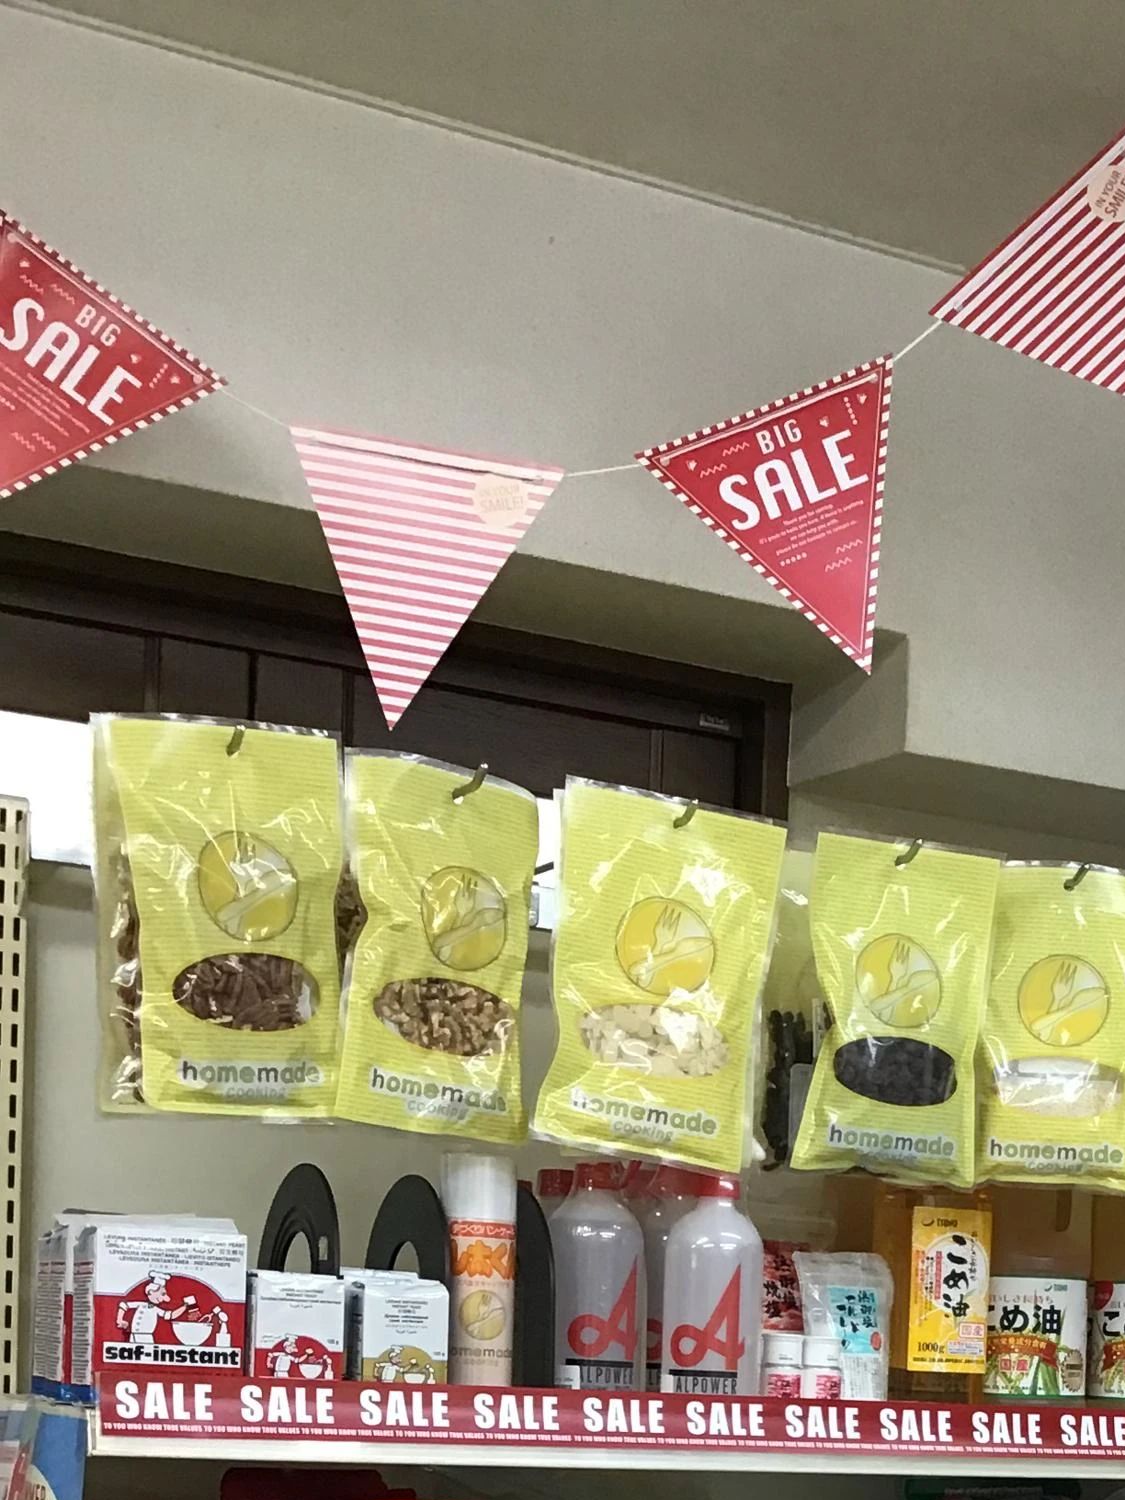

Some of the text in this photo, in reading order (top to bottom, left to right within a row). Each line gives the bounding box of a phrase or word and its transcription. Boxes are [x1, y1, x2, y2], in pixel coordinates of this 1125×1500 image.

[75, 304, 121, 347] BIG
[0, 297, 143, 426] SALE
[755, 419, 802, 455] BIG
[719, 429, 869, 530] SALE
[181, 1059, 318, 1083] homemade
[372, 1068, 508, 1112] homemade
[571, 1091, 716, 1134] homemade
[828, 1124, 954, 1156] homemade
[990, 1141, 1123, 1164] homemade
[105, 1346, 240, 1365] saf-instant
[115, 1381, 213, 1421] SALE
[360, 1390, 450, 1427] SALE
[687, 1401, 765, 1437] SALE
[972, 1412, 1042, 1444] SALE
